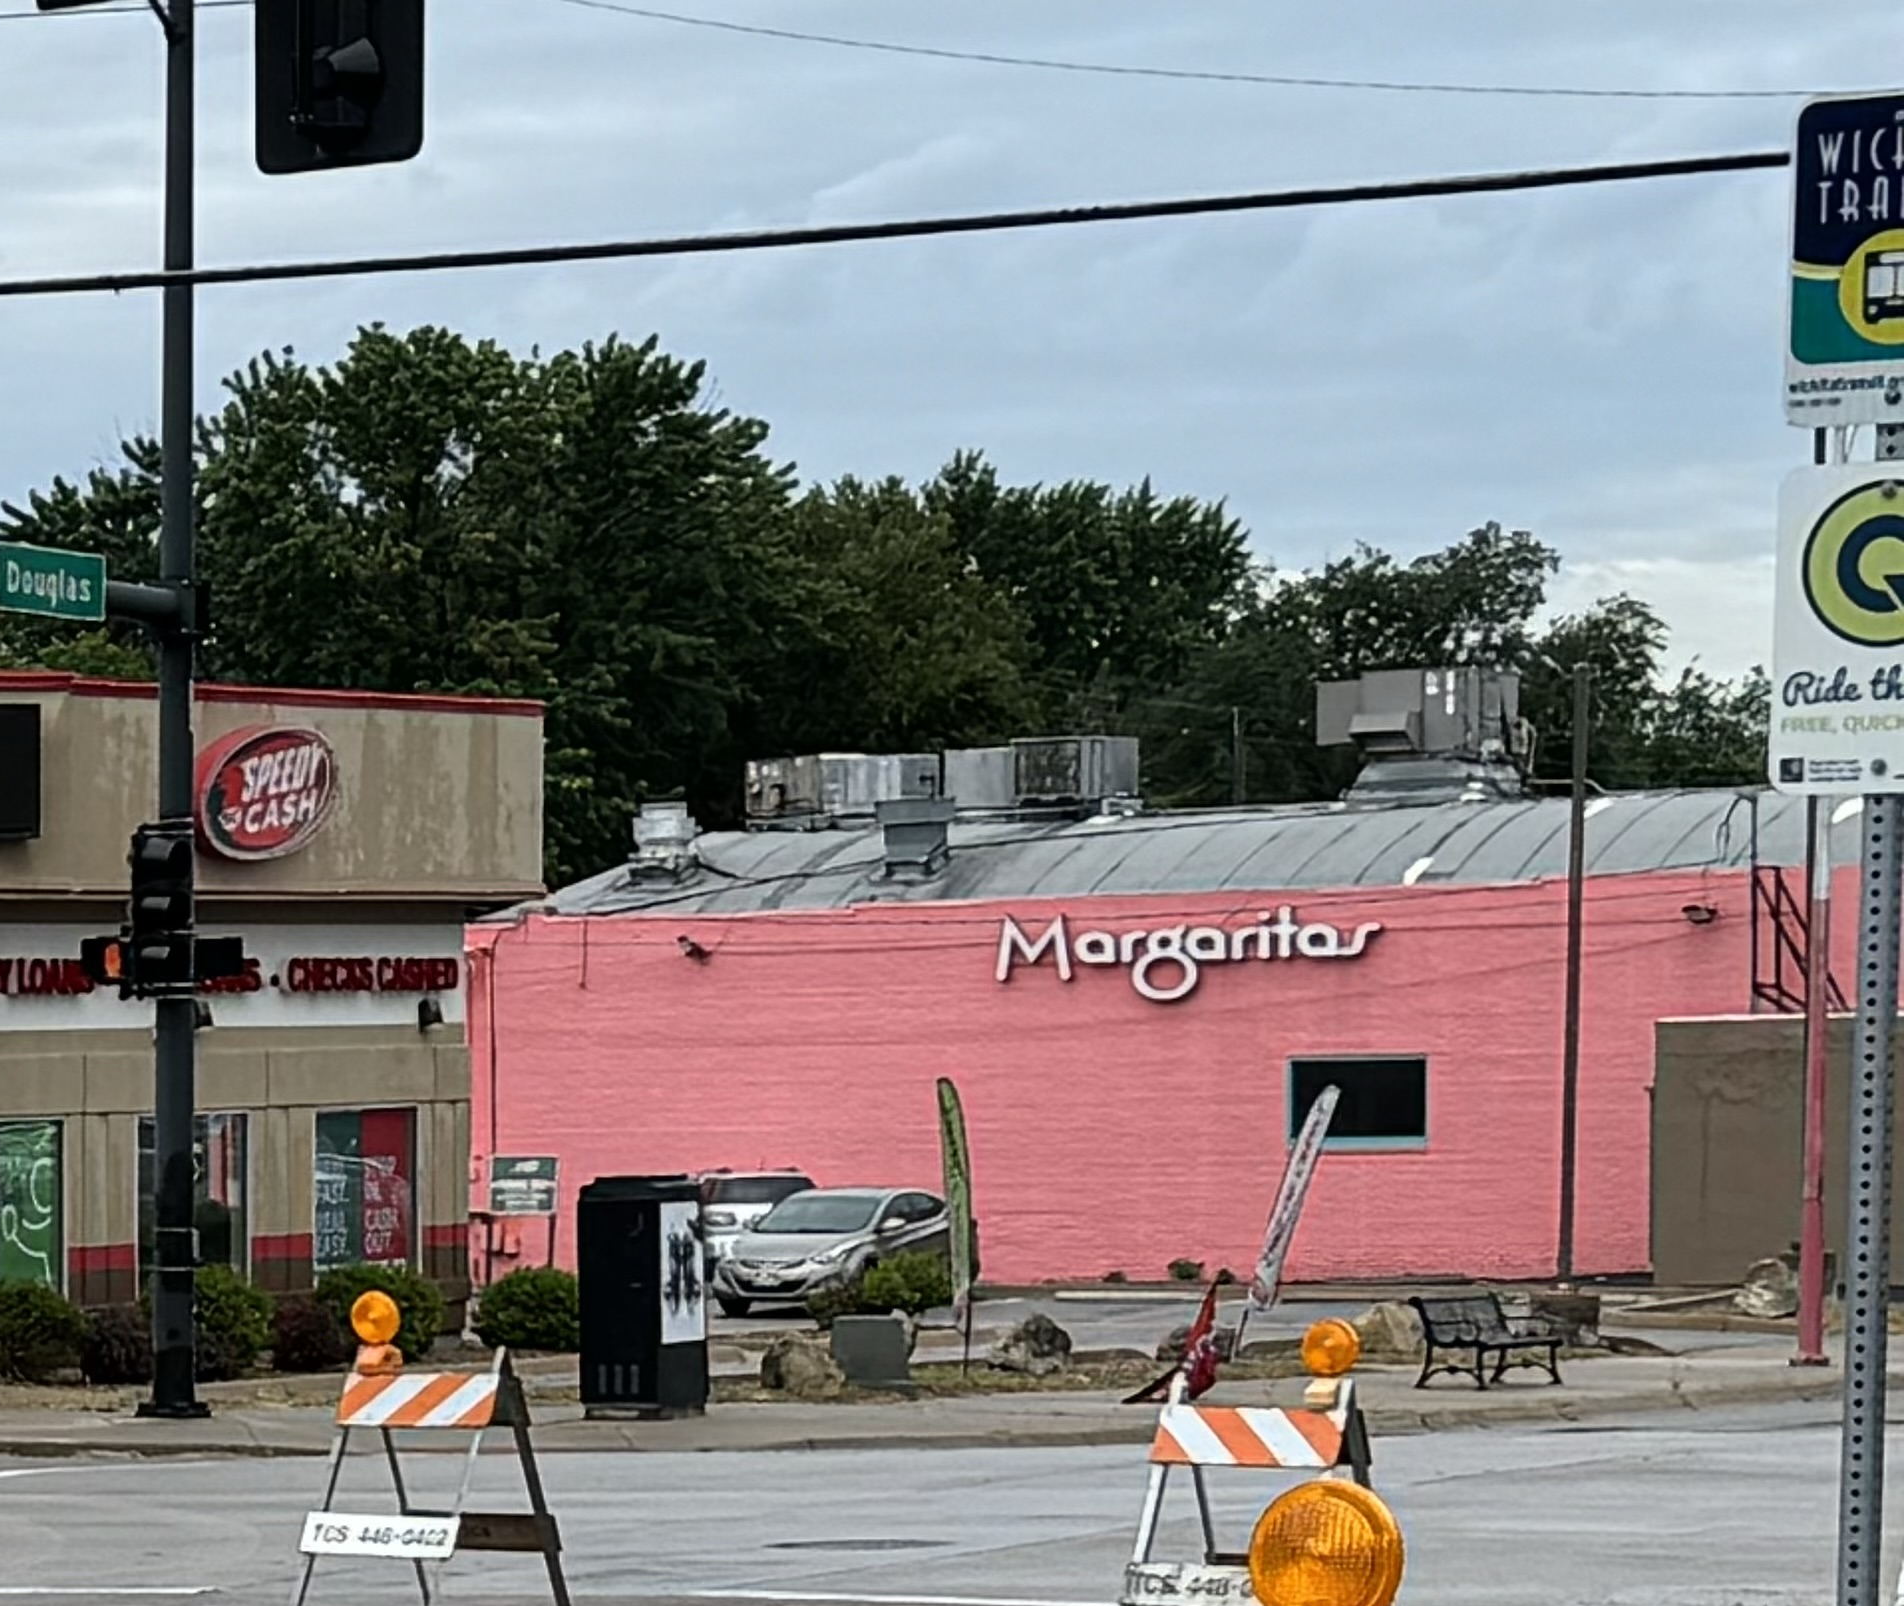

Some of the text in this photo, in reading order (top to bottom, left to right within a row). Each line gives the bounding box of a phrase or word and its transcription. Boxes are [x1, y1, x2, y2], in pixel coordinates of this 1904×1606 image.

[1817, 176, 1904, 224] TRA
[6, 560, 91, 609] Douglas
[1783, 666, 1862, 707] Ride
[241, 741, 322, 802] SPEEDY
[288, 956, 374, 992] CHECKS
[377, 956, 459, 991] CASHED
[996, 905, 1382, 1001] Margaritas
